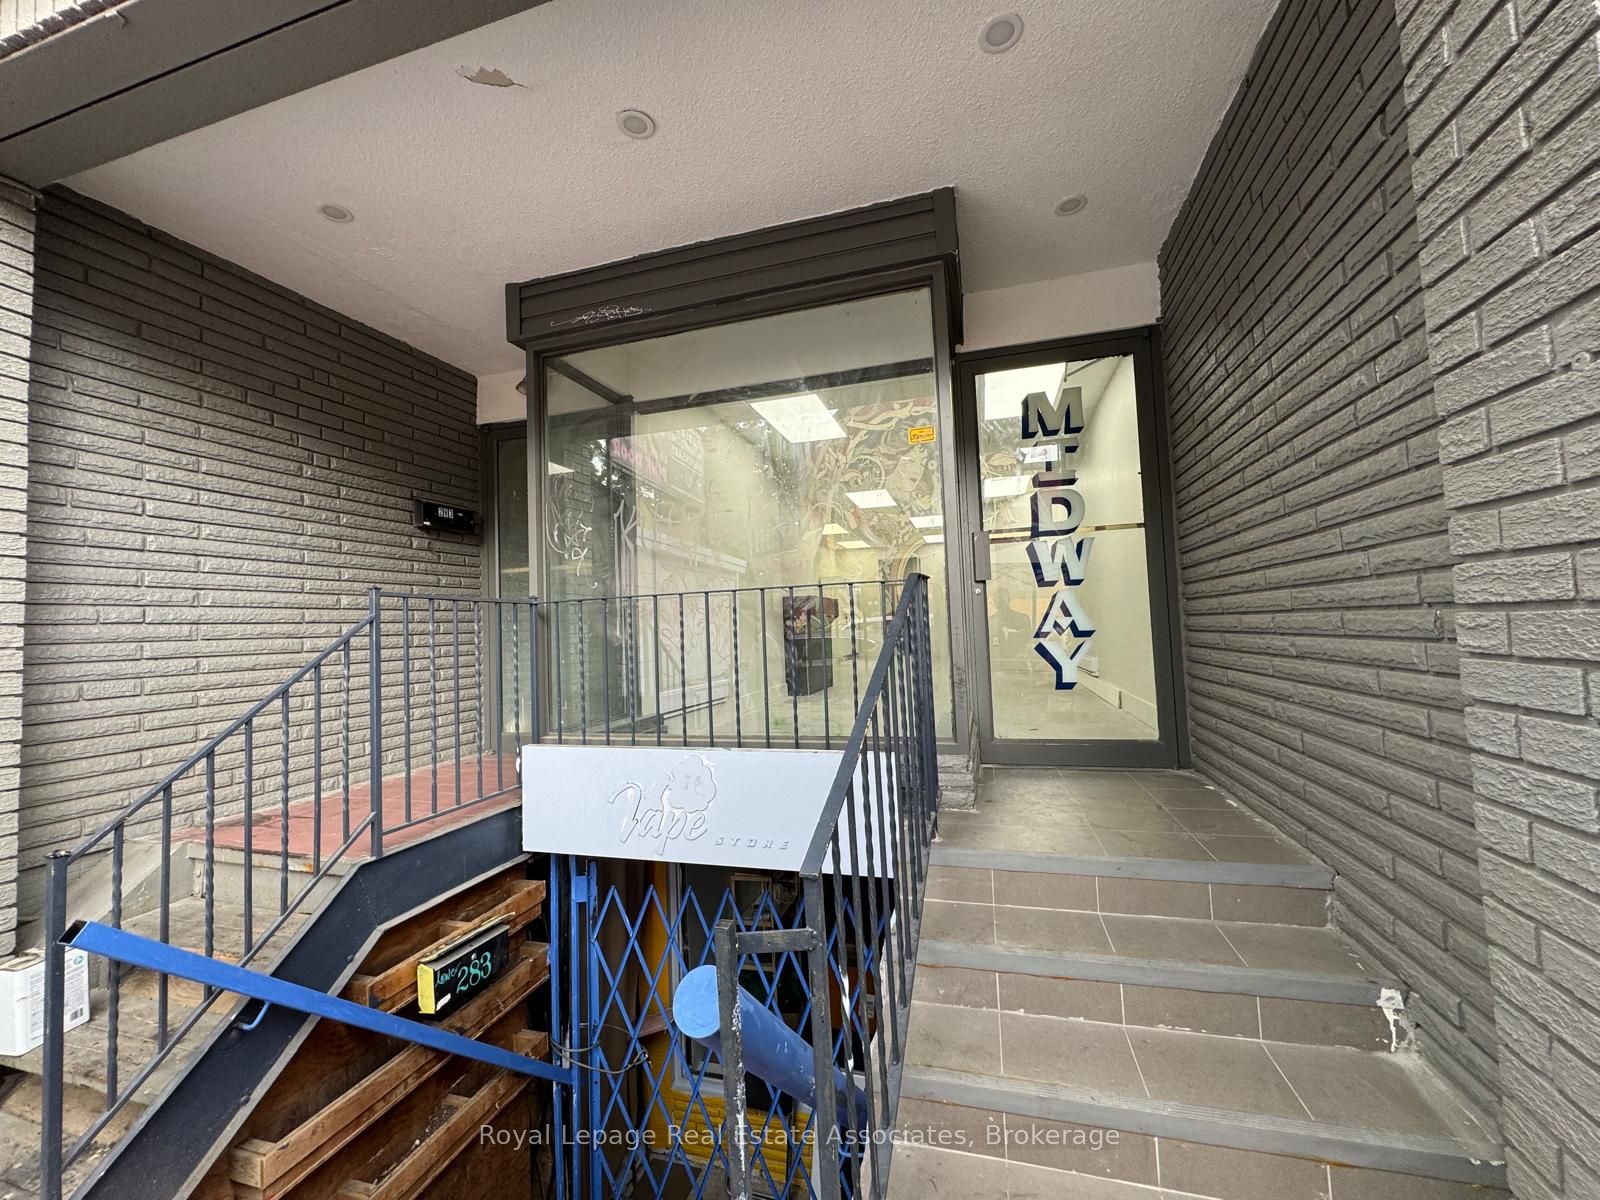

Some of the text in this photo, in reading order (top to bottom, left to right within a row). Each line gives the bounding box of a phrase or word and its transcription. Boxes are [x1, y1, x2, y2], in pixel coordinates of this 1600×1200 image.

[1021, 385, 1096, 690] MIDWAY
[608, 781, 708, 856] Vape
[714, 836, 791, 850] STORE
[456, 951, 492, 994] 283
